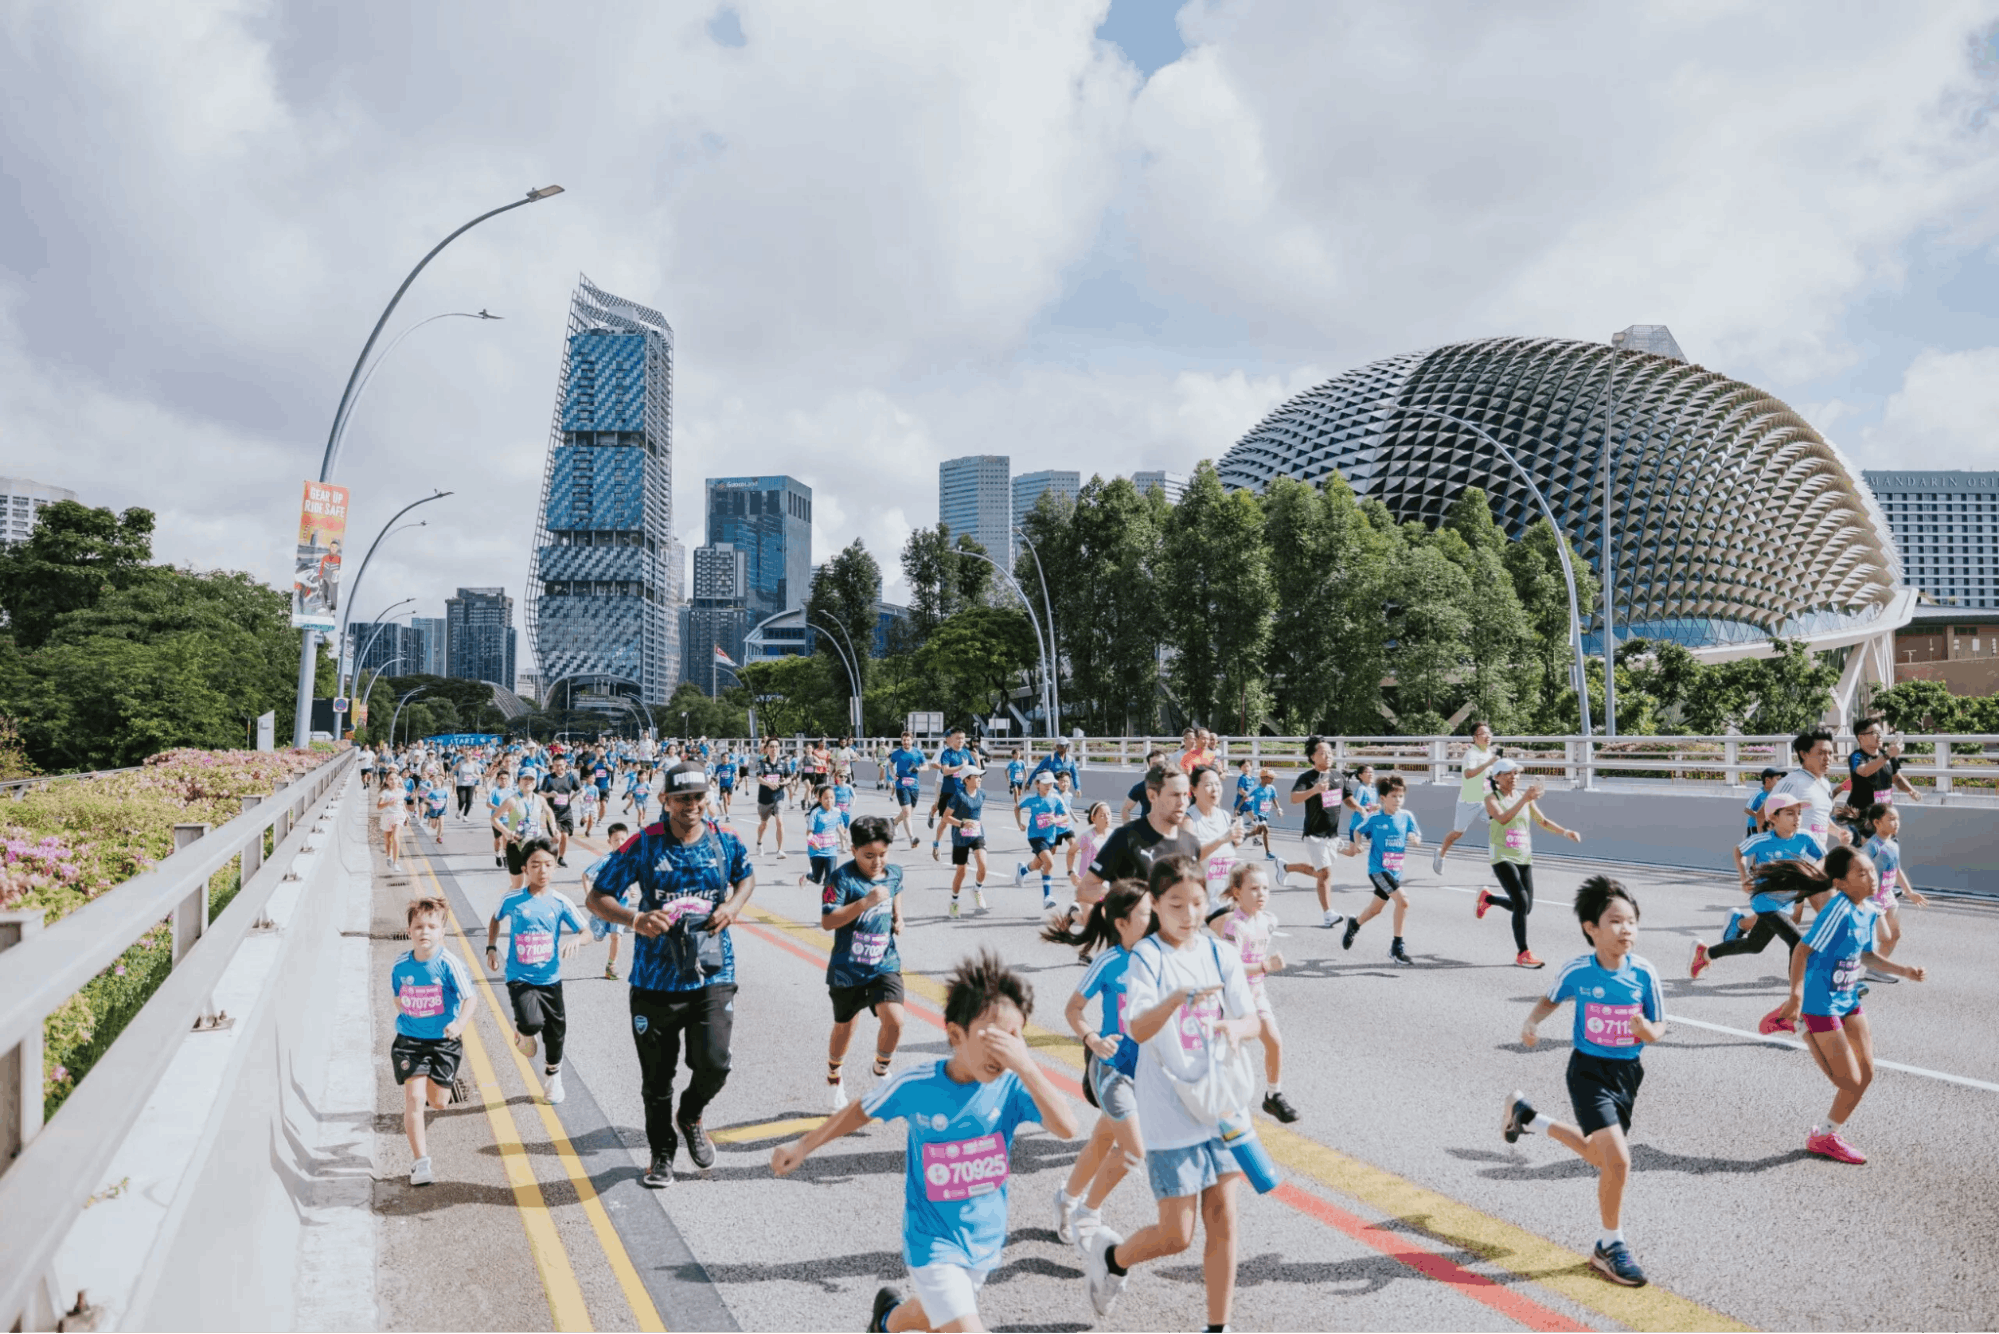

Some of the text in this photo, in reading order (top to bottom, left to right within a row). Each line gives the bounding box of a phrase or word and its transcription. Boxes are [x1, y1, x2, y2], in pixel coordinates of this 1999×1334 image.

[1868, 476, 1999, 487] MANDARIN ORI
[310, 486, 344, 506] GEAR UP
[304, 499, 346, 519] RIDE SAFE
[948, 1153, 1007, 1184] 70925
